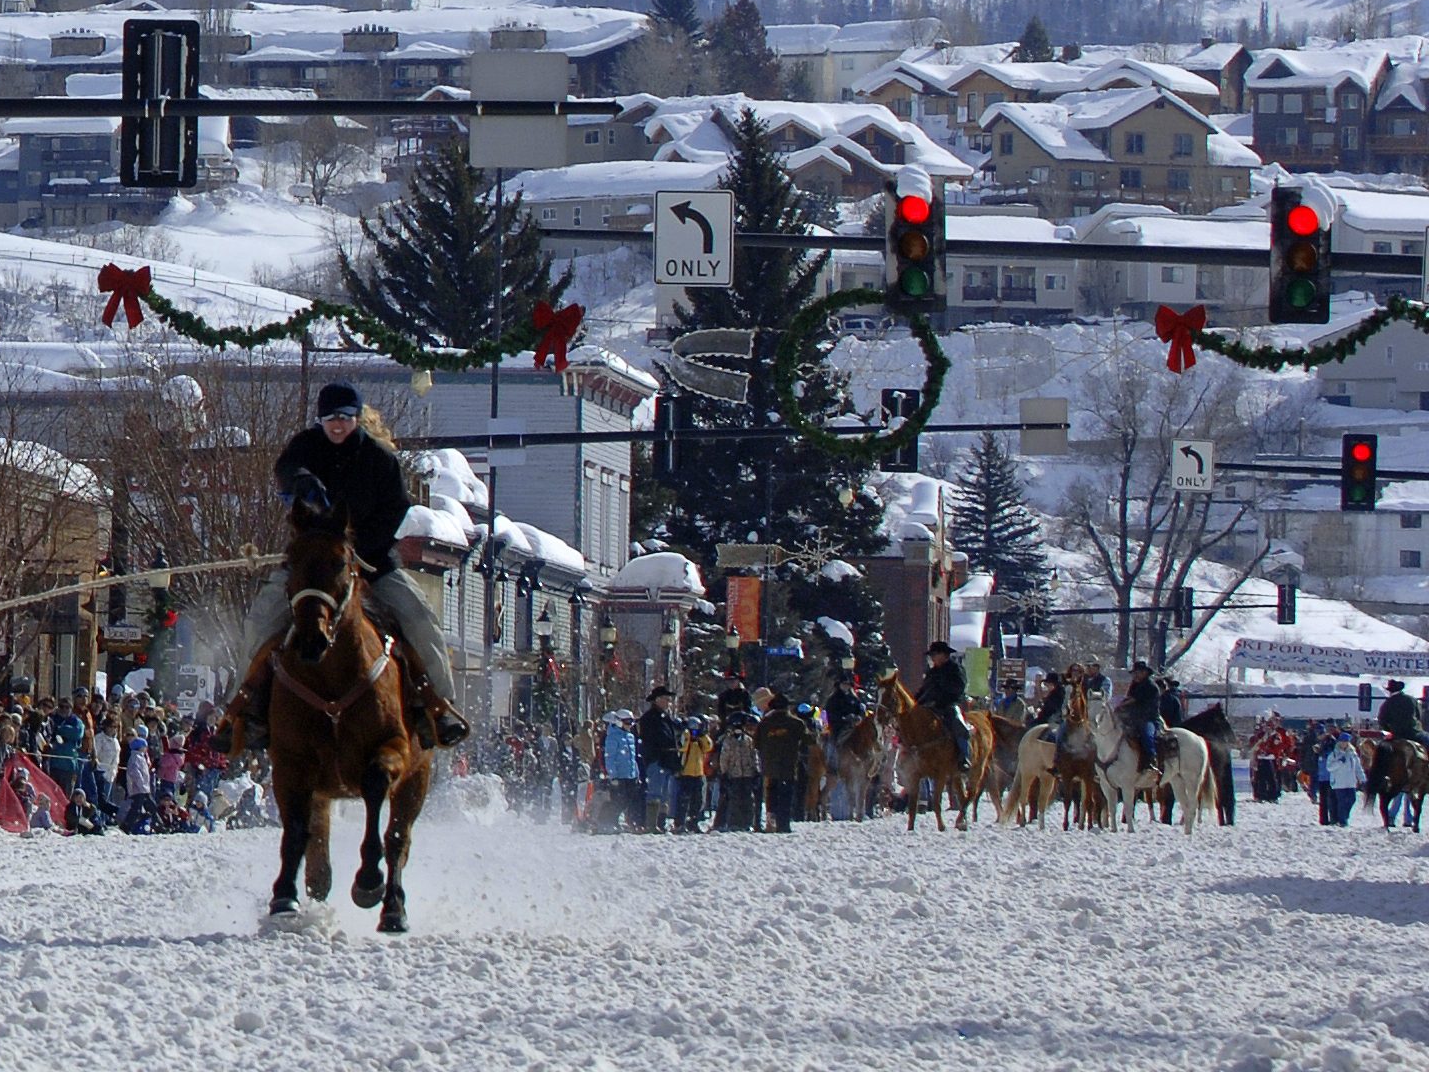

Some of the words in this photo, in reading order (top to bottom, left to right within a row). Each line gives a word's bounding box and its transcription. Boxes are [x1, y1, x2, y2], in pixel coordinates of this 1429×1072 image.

[666, 259, 721, 277] ONLY
[1177, 476, 1207, 487] ONLY
[1236, 640, 1262, 651] SKI
[1269, 643, 1303, 654] FOR
